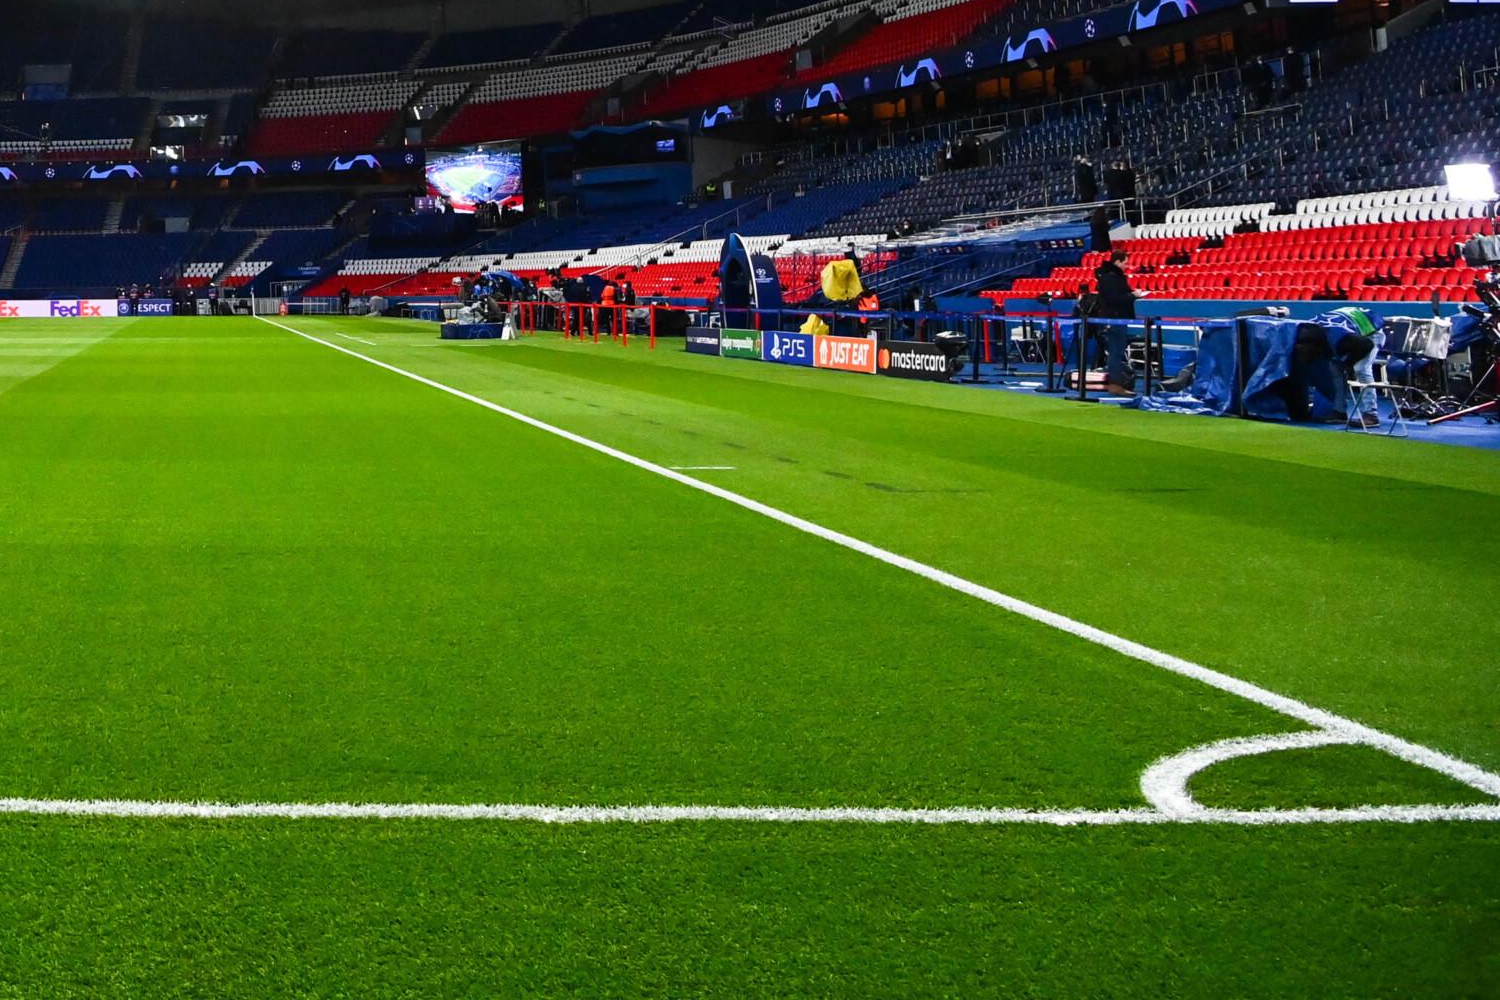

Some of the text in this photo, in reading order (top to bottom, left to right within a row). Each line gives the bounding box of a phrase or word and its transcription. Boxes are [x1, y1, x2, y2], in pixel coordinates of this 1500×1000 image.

[50, 300, 101, 317] FedEx
[137, 303, 171, 312] ESPECT
[782, 338, 805, 357] PS5
[829, 341, 870, 366] JUST EAT
[891, 348, 946, 372] mastercard
